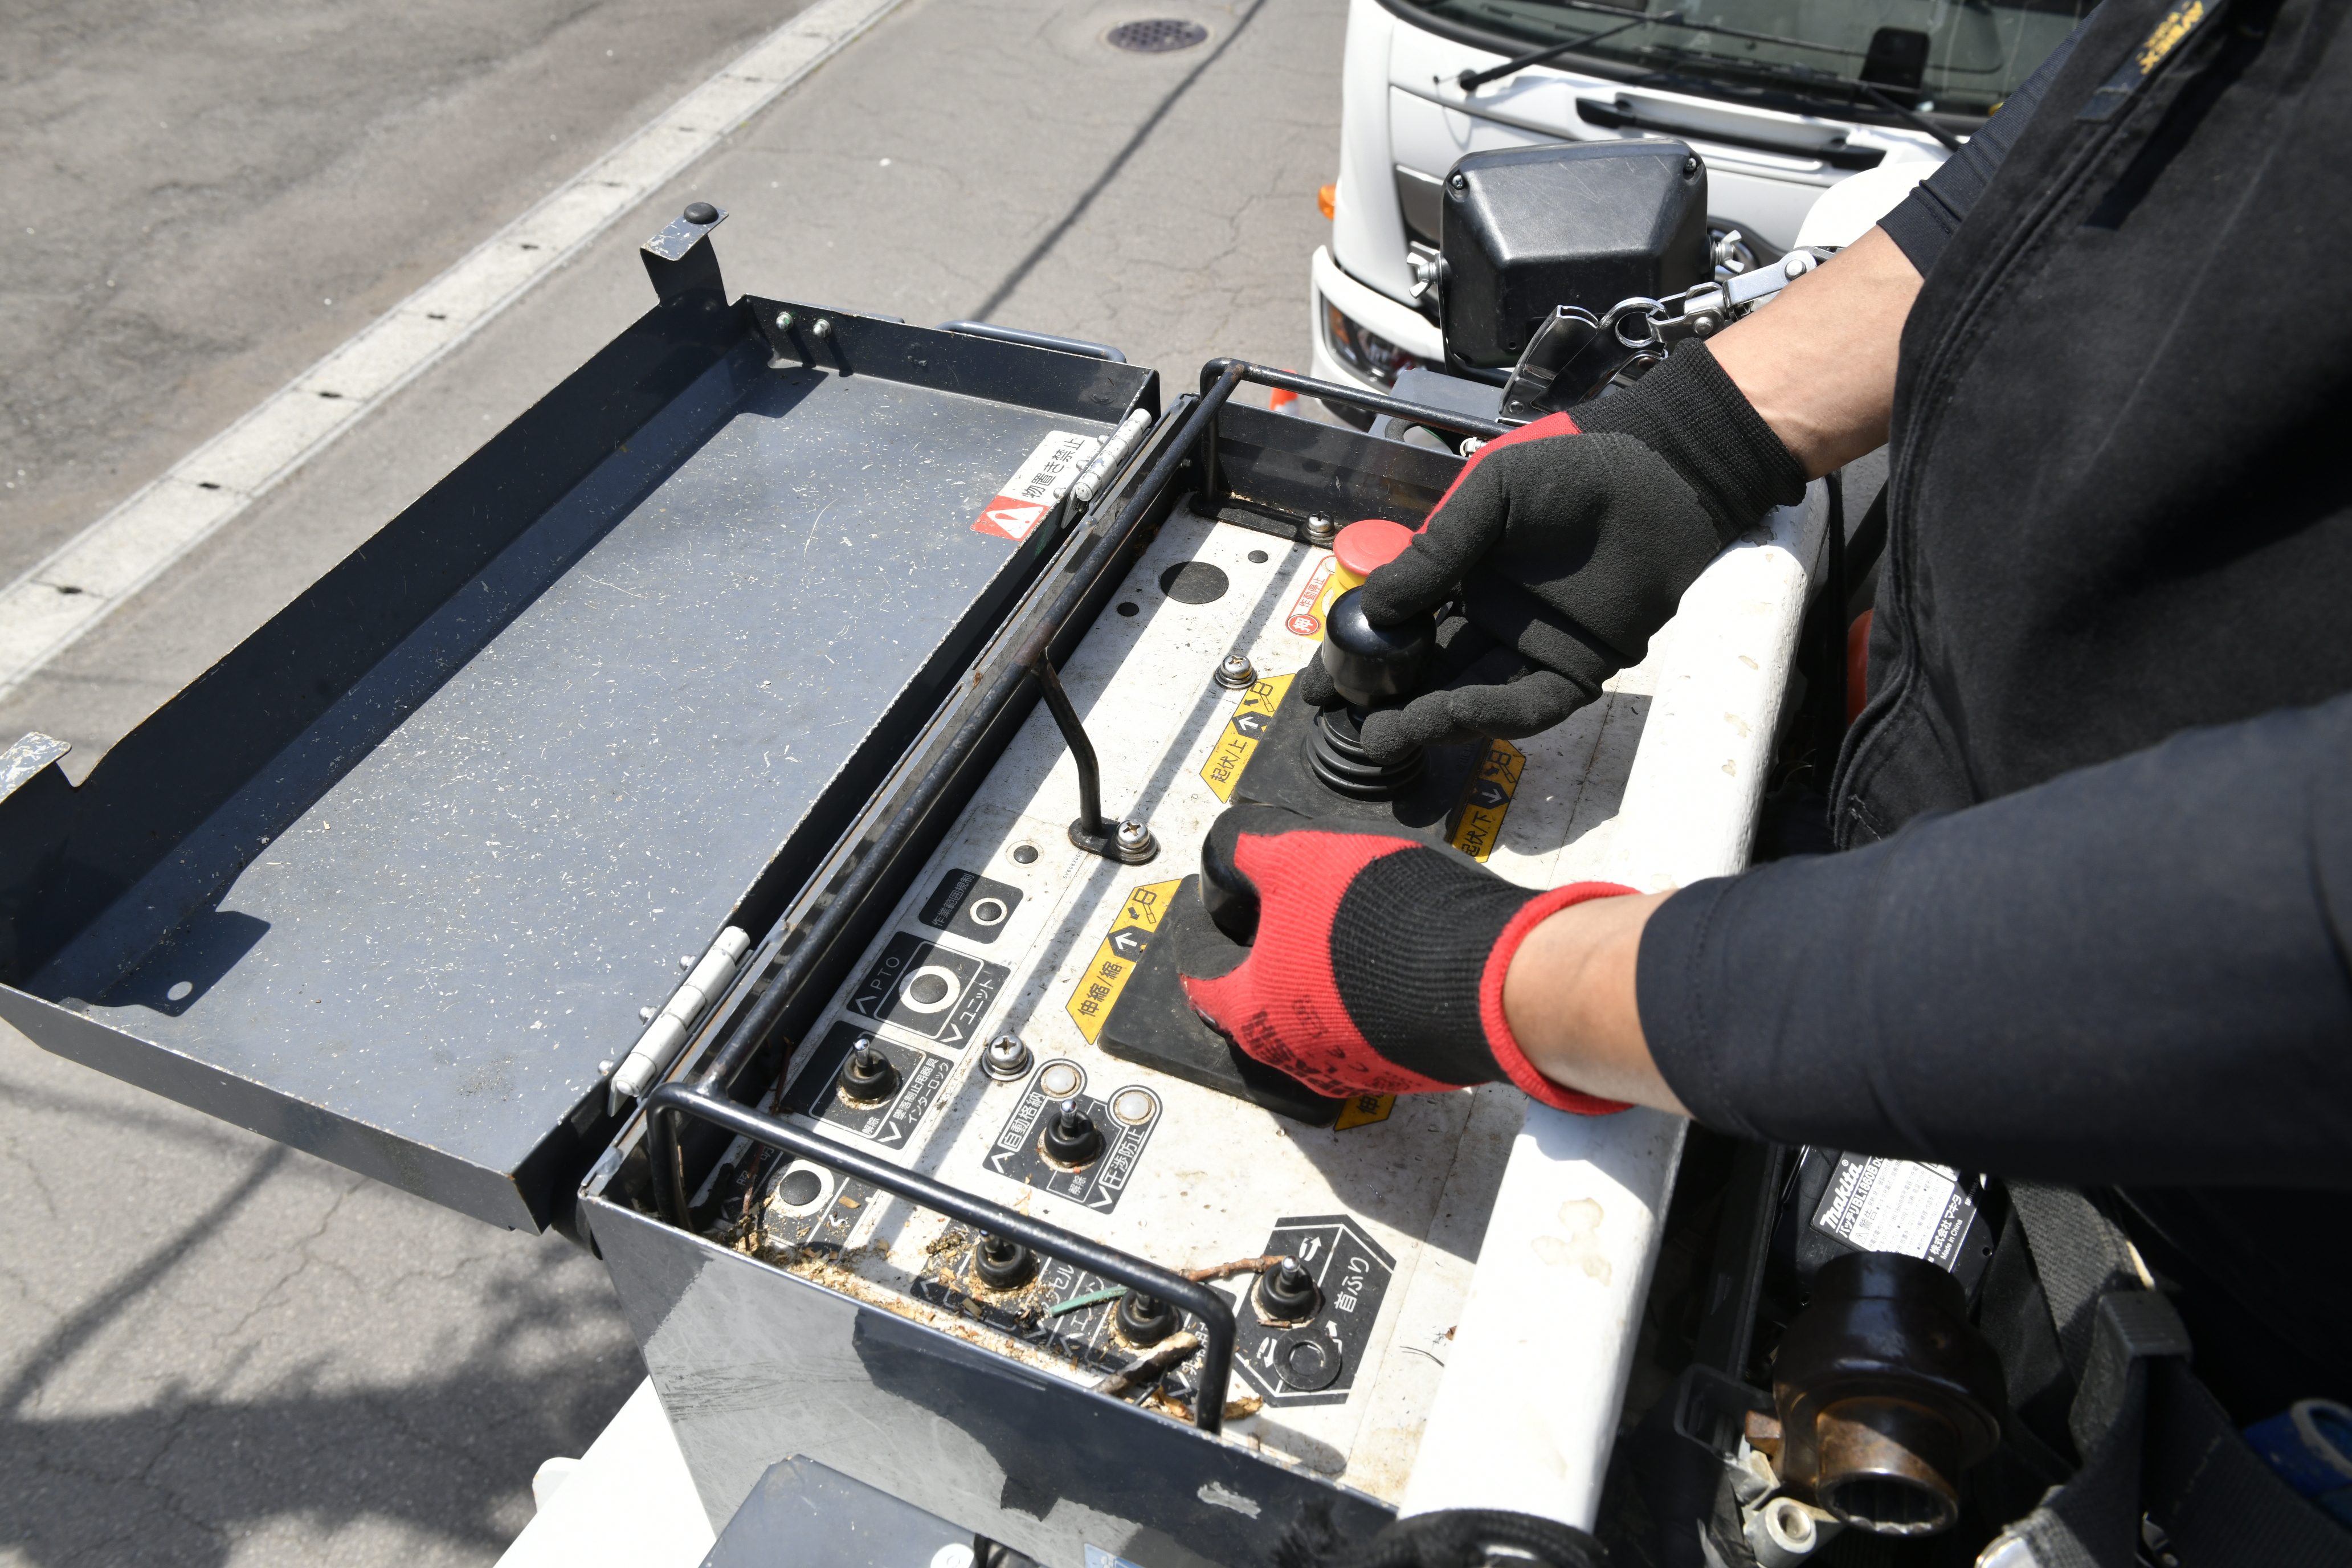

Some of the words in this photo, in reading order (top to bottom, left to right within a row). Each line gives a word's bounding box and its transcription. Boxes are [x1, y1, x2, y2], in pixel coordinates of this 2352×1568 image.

[1022, 438, 1085, 498] 物置き禁止
[1298, 577, 1325, 608] 作動停止
[1293, 617, 1313, 632] 押
[1210, 740, 1247, 783] 起伏/上
[932, 873, 974, 926] 作業範囲規制
[871, 957, 900, 990] PTO
[1077, 961, 1122, 1017] 伸縮/縮
[960, 979, 993, 1024] ユニット
[893, 1058, 938, 1120] 墜落制止用器具
[908, 1062, 949, 1124] インターロック
[862, 1116, 880, 1135] 解除
[1004, 1092, 1047, 1148] 自動格納
[1104, 1129, 1145, 1185] 干渉防止
[1068, 1175, 1087, 1195] 解除
[1859, 1208, 1878, 1231] 警告
[1930, 1194, 1962, 1255] 株式会社マキタ
[1940, 1242, 1953, 1260] Made
[1950, 1218, 1963, 1236] China
[1070, 1276, 1104, 1331] エンン
[1334, 1257, 1369, 1313] 首ふり
